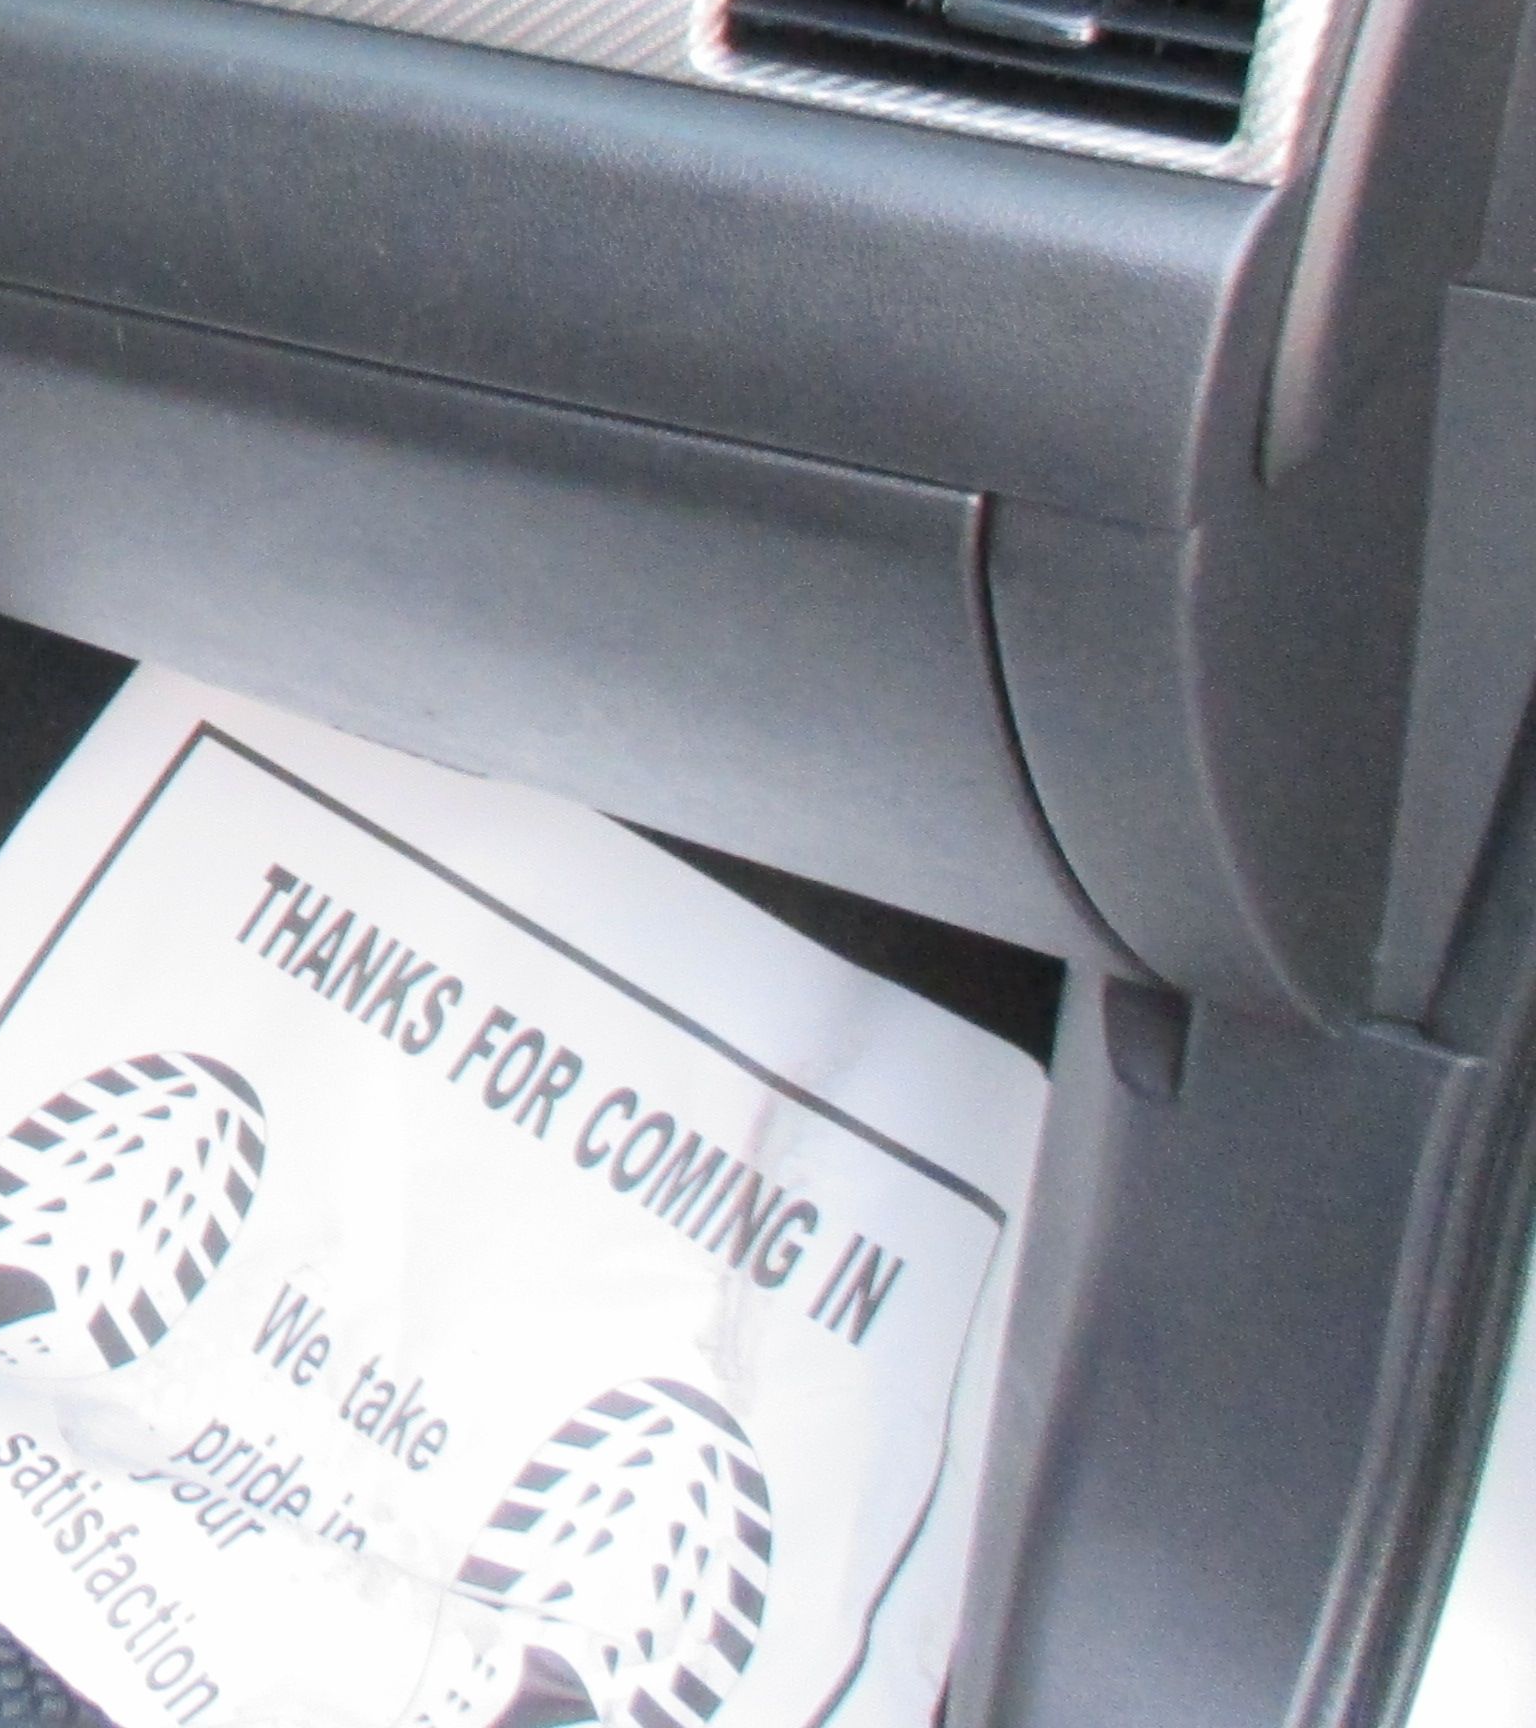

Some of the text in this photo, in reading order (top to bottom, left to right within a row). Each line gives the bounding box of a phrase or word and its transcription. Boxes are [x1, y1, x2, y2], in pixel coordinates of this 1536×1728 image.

[237, 862, 906, 1346] THANKS FOR COMING IN
[253, 1283, 448, 1471] We take
[169, 1418, 368, 1552] pride in
